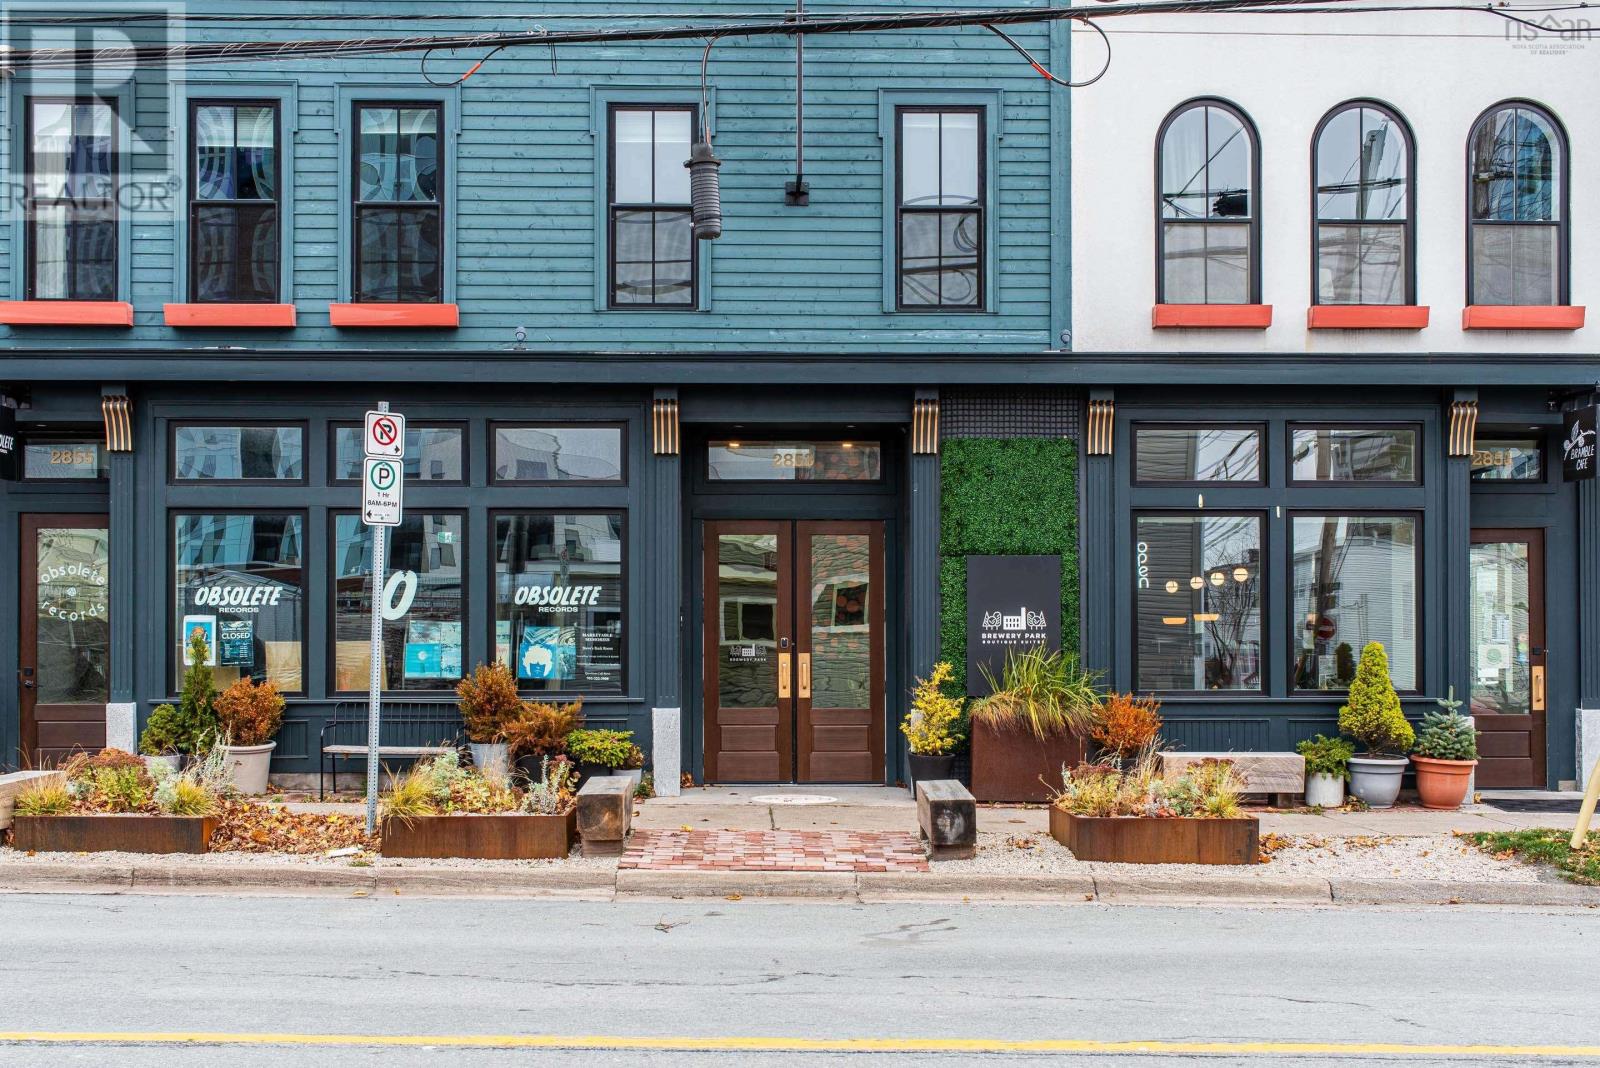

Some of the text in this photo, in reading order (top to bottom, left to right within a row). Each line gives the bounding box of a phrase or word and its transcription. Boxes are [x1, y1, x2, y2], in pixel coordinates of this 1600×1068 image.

[1570, 444, 1595, 460] BRAMBLE
[41, 562, 105, 586] obsolete
[1137, 542, 1149, 589] open
[194, 586, 283, 606] OBSOLETE
[514, 585, 602, 606] OBSOLETE
[41, 601, 105, 621] records
[221, 632, 251, 640] CLOSED
